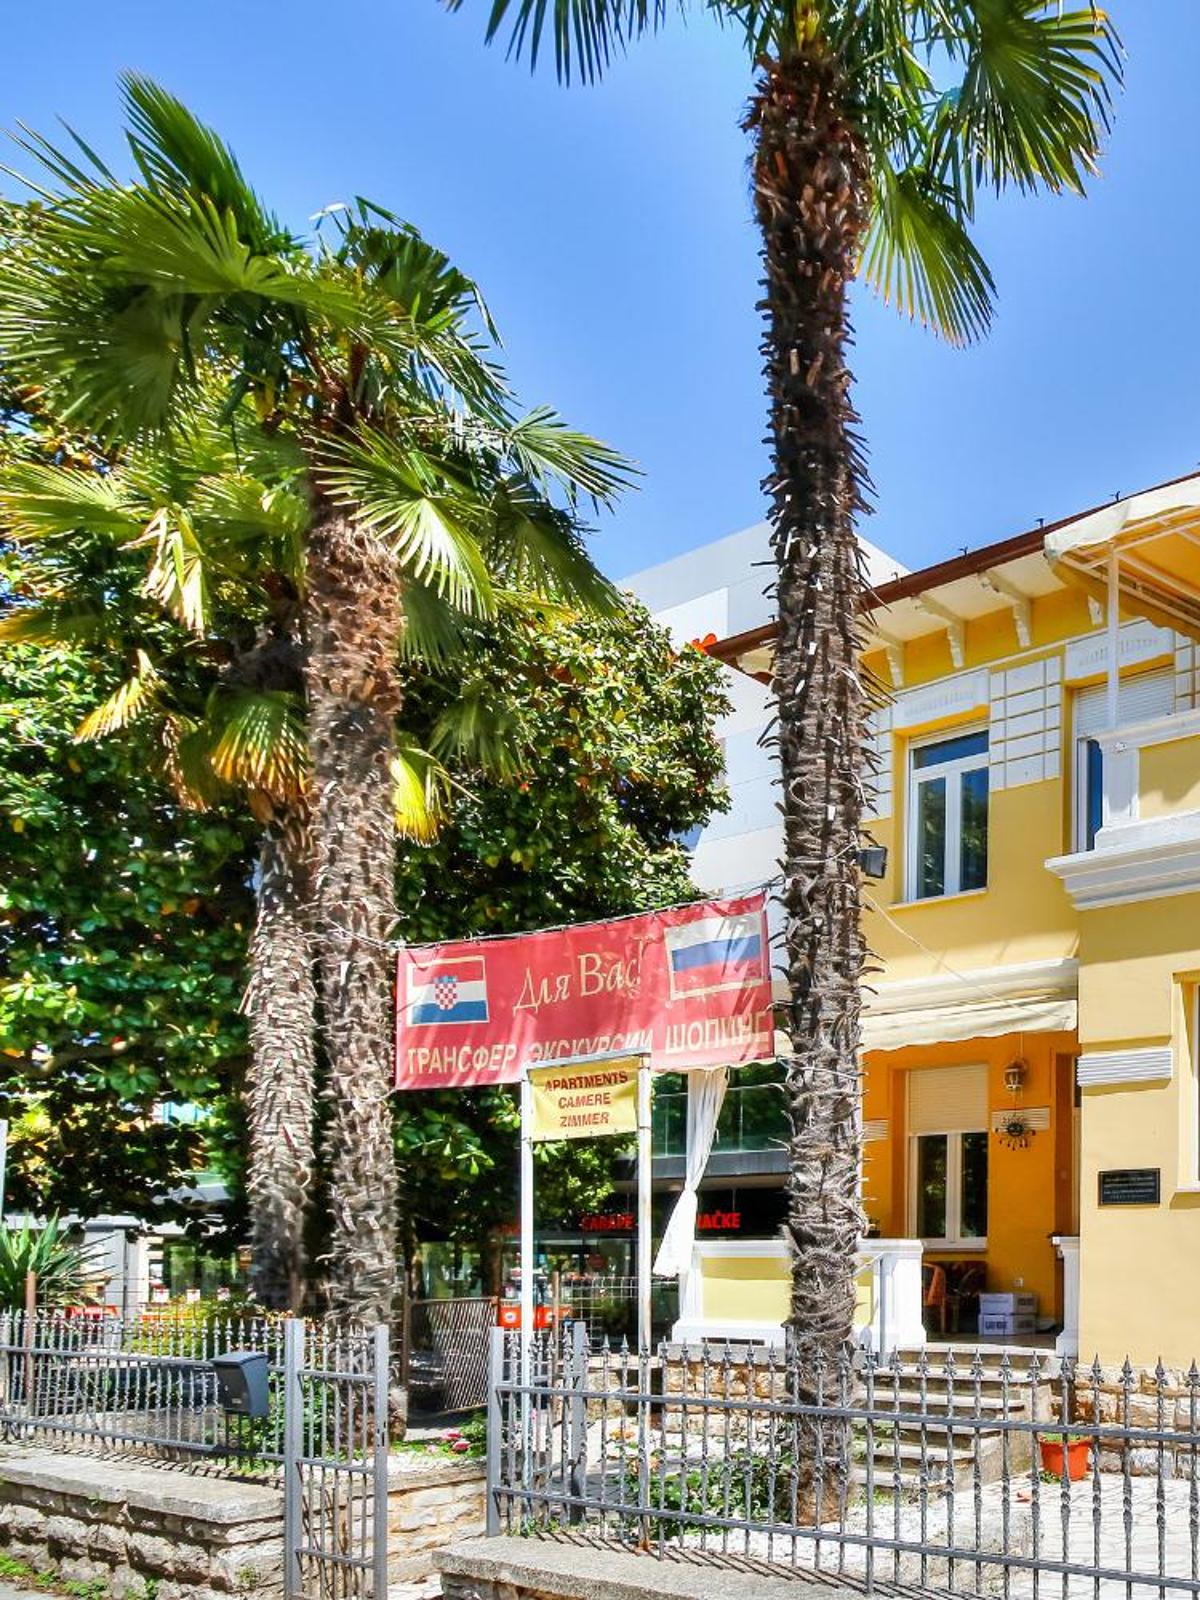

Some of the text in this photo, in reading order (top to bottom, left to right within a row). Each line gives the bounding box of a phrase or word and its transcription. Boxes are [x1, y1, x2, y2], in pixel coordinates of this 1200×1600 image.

[512, 965, 570, 1017] Для
[407, 1042, 517, 1075] ТРАНСФЕР
[665, 1011, 768, 1055] ШОПИНГ
[545, 1070, 628, 1092] APARTMENTS
[558, 1093, 611, 1109] CAMERE
[560, 1112, 609, 1127] ZIMMER
